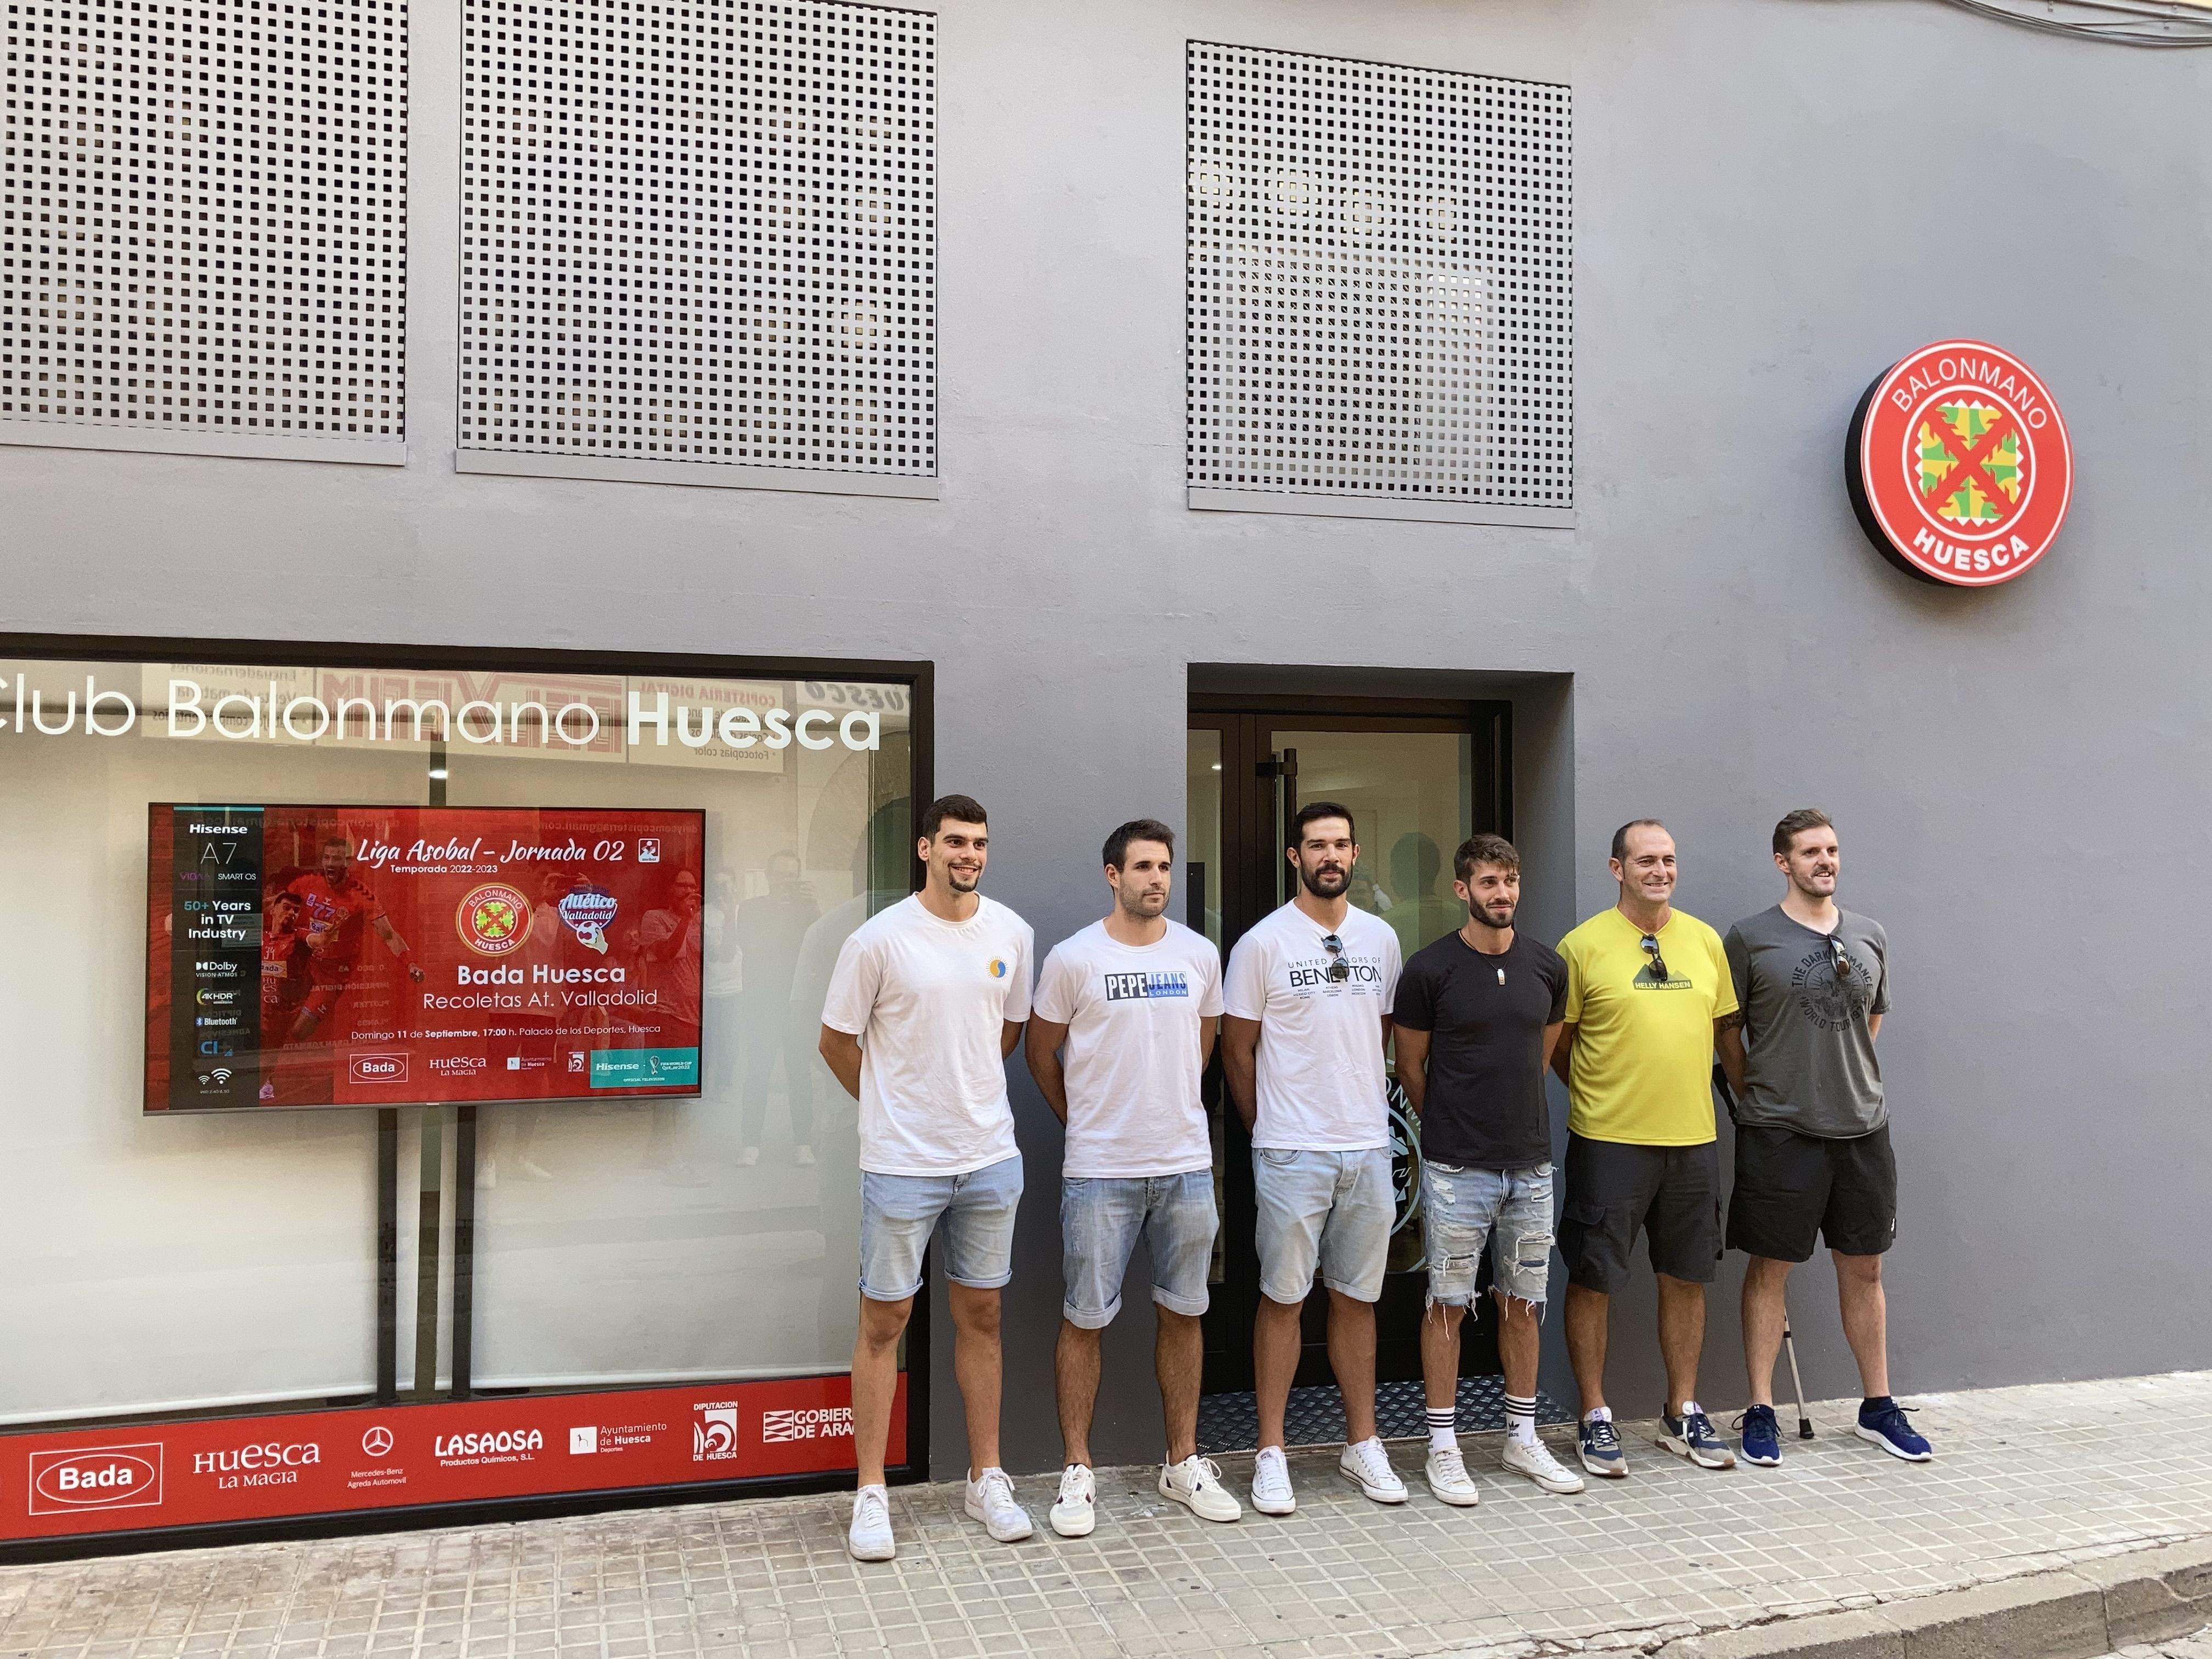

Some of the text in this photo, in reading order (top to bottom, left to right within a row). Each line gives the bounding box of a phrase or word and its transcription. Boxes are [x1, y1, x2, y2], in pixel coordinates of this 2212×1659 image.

[1891, 357, 2047, 430] BALONMANO
[1912, 526, 2030, 572] HUESCA
[168, 679, 600, 746] Balonmano
[628, 690, 881, 751] Huesca
[189, 824, 248, 834] Hisense
[200, 842, 237, 865] A7
[357, 838, 401, 869] Liga
[406, 837, 482, 862] Asobal
[500, 838, 586, 863] Jornada
[593, 840, 625, 861] 02
[391, 864, 498, 874] Temporada 2022-2023
[184, 900, 251, 911] 50+ Years
[469, 890, 523, 910] BALONMANO
[201, 913, 234, 924] in TV
[188, 928, 247, 941] Industry
[475, 938, 516, 951] HUESCA
[210, 962, 238, 972] Dolby
[1288, 958, 1327, 968] UNITED
[1792, 966, 1807, 987] THE
[1801, 950, 1831, 968] DARK
[458, 964, 625, 985] Bada Huesca
[1148, 973, 1186, 990] JEANS
[1289, 966, 1381, 987] BENETON
[1107, 974, 1148, 999] PEPE
[423, 989, 657, 1009] Recoletas At. Valladolid
[204, 1018, 238, 1026] Bluetooth
[1799, 996, 1826, 1029] WORLD
[1830, 1018, 1852, 1032] TOUR
[352, 1031, 394, 1040] Domingo
[397, 1030, 407, 1039] 11
[410, 1030, 423, 1039] de
[425, 1029, 480, 1040] Septiembre,
[483, 1028, 506, 1036] 17:00
[519, 1028, 553, 1036] Palacio
[584, 1025, 627, 1035] Deportes,
[628, 1025, 661, 1033] Huesca
[363, 1062, 395, 1073] Bada
[429, 1057, 487, 1069] Huesca
[693, 1401, 738, 1411] DIPUTACION
[794, 1407, 854, 1424] GOBIER
[600, 1422, 667, 1437] Ayuntamiento
[794, 1422, 854, 1440] DE ARA
[435, 1429, 544, 1457] LASAOSA
[600, 1435, 651, 1446] de Huesca
[193, 1442, 321, 1475] Huesca
[440, 1457, 479, 1467] Productos
[706, 1451, 737, 1460] HUESCA
[58, 1464, 133, 1491] Bada
[351, 1468, 404, 1479] Mercedes-Benz
